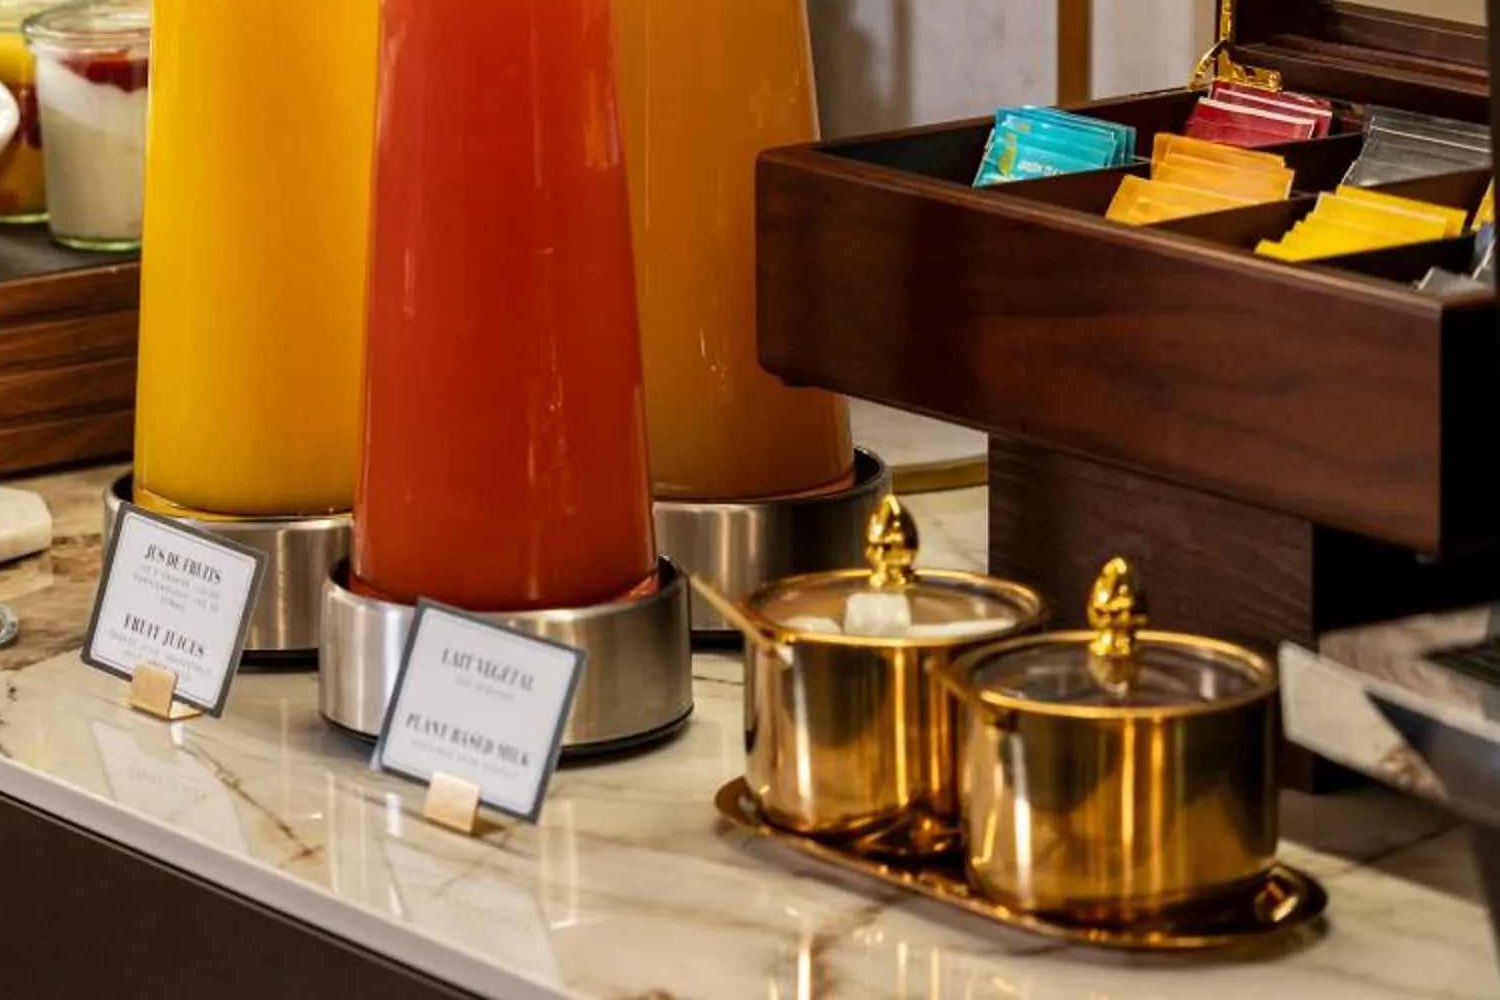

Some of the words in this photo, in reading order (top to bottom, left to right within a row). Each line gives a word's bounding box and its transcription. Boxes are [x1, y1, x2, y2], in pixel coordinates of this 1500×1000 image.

[183, 559, 221, 584] FRUITS
[124, 614, 160, 639] FRUIT
[162, 630, 205, 657] JUICES
[442, 648, 474, 670] LAIT
[406, 712, 448, 738] PLANT
[450, 728, 494, 755] BASED
[497, 743, 529, 767] MILK
